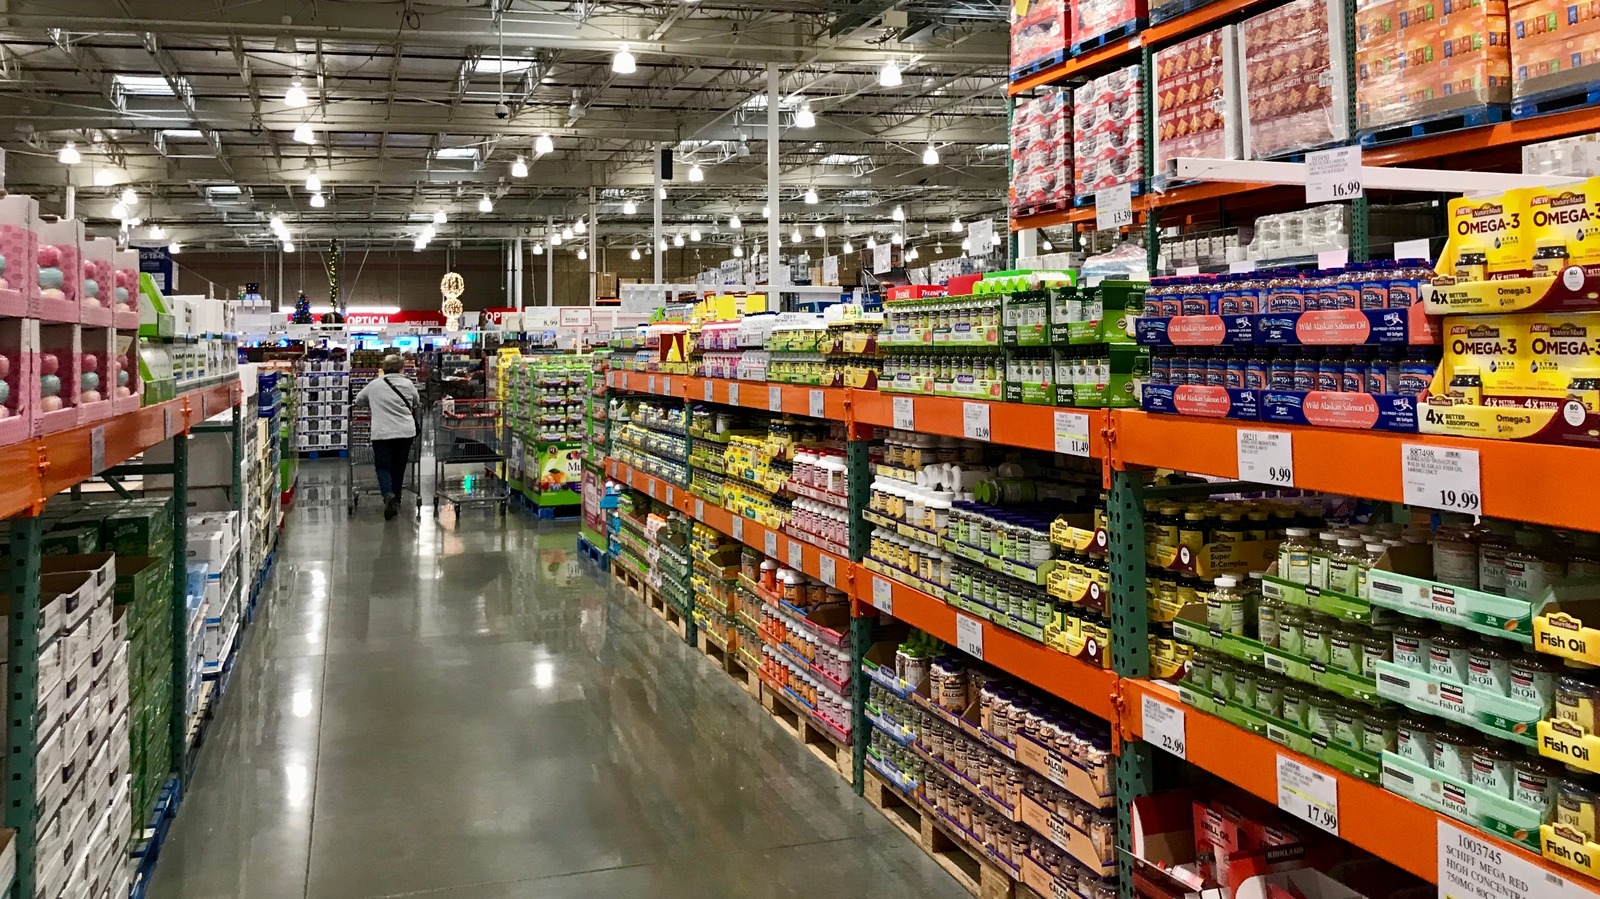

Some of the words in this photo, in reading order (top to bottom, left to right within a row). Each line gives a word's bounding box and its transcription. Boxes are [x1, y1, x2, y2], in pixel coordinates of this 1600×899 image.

[1333, 181, 1360, 197] 16.99
[1532, 197, 1549, 205] NEW
[1114, 210, 1131, 223] 13.39
[1457, 207, 1472, 216] NEW
[1458, 214, 1520, 235] OMEGA-3
[1431, 290, 1448, 304] 4x
[1498, 287, 1531, 296] Omega-3
[1052, 327, 1067, 335] Vitamin
[1299, 323, 1311, 331] Wild
[1335, 322, 1355, 330] Salmon
[1452, 326, 1466, 334] NEW
[1532, 324, 1548, 332] NEW
[1453, 339, 1517, 355] OMEGA-3
[1321, 403, 1341, 411] Alaskan
[1343, 404, 1363, 412] Salmon
[1365, 404, 1374, 412] Oil
[1525, 399, 1538, 409] 4x
[1426, 409, 1444, 425] 4x
[1496, 415, 1530, 424] Omega-3
[976, 428, 989, 437] 12.99
[1072, 440, 1088, 452] 11.49
[1410, 448, 1434, 458] 887498
[1270, 467, 1291, 482] 9.99
[1440, 490, 1478, 509] 19.99
[1050, 528, 1062, 536] Super
[1210, 553, 1231, 561] Super
[1210, 560, 1248, 568] B-Complex
[1514, 579, 1527, 588] Oil
[1431, 602, 1444, 612] Fish
[1446, 605, 1457, 615] Oil
[1550, 619, 1579, 630] NatureMade
[1541, 632, 1565, 648] Fish
[1568, 638, 1586, 654] Oil
[969, 643, 982, 656] 12.99
[1332, 650, 1336, 658] E
[1367, 657, 1372, 666] E
[1407, 654, 1421, 664] Oil
[1438, 665, 1452, 674] Oil
[1478, 676, 1493, 686] Oil
[1441, 683, 1463, 693] KIRKLAND
[1521, 689, 1536, 699] Oil
[1440, 700, 1452, 710] Fish
[1454, 704, 1465, 714] Oil
[1563, 710, 1577, 720] Oil
[1162, 734, 1184, 754] 22.99
[1544, 736, 1568, 752] Fish
[1572, 745, 1589, 761] Oil
[1401, 745, 1412, 755] Oil
[1044, 756, 1069, 777] CALCIUM
[1482, 777, 1496, 786] Oil
[1444, 783, 1465, 794] KIRKLAND
[1442, 799, 1455, 812] Fish
[1456, 804, 1468, 815] Oil
[1307, 804, 1336, 829] 17.99
[1564, 814, 1579, 826] Oil
[1046, 819, 1071, 841] CALCIUM
[1202, 822, 1219, 837] KRILL
[1267, 847, 1304, 859] KIRKLAND
[1458, 834, 1502, 865] 1003745
[1546, 839, 1571, 860] Fish
[1574, 851, 1591, 868] Oil
[1446, 845, 1476, 866] SCHIFF
[1480, 862, 1506, 882] MEGA
[1508, 876, 1529, 892] RED
[1446, 858, 1469, 876] HIGH
[1471, 870, 1526, 899] CONCENTR
[1446, 871, 1474, 892] 750MG
[1476, 886, 1498, 899] 80CT
